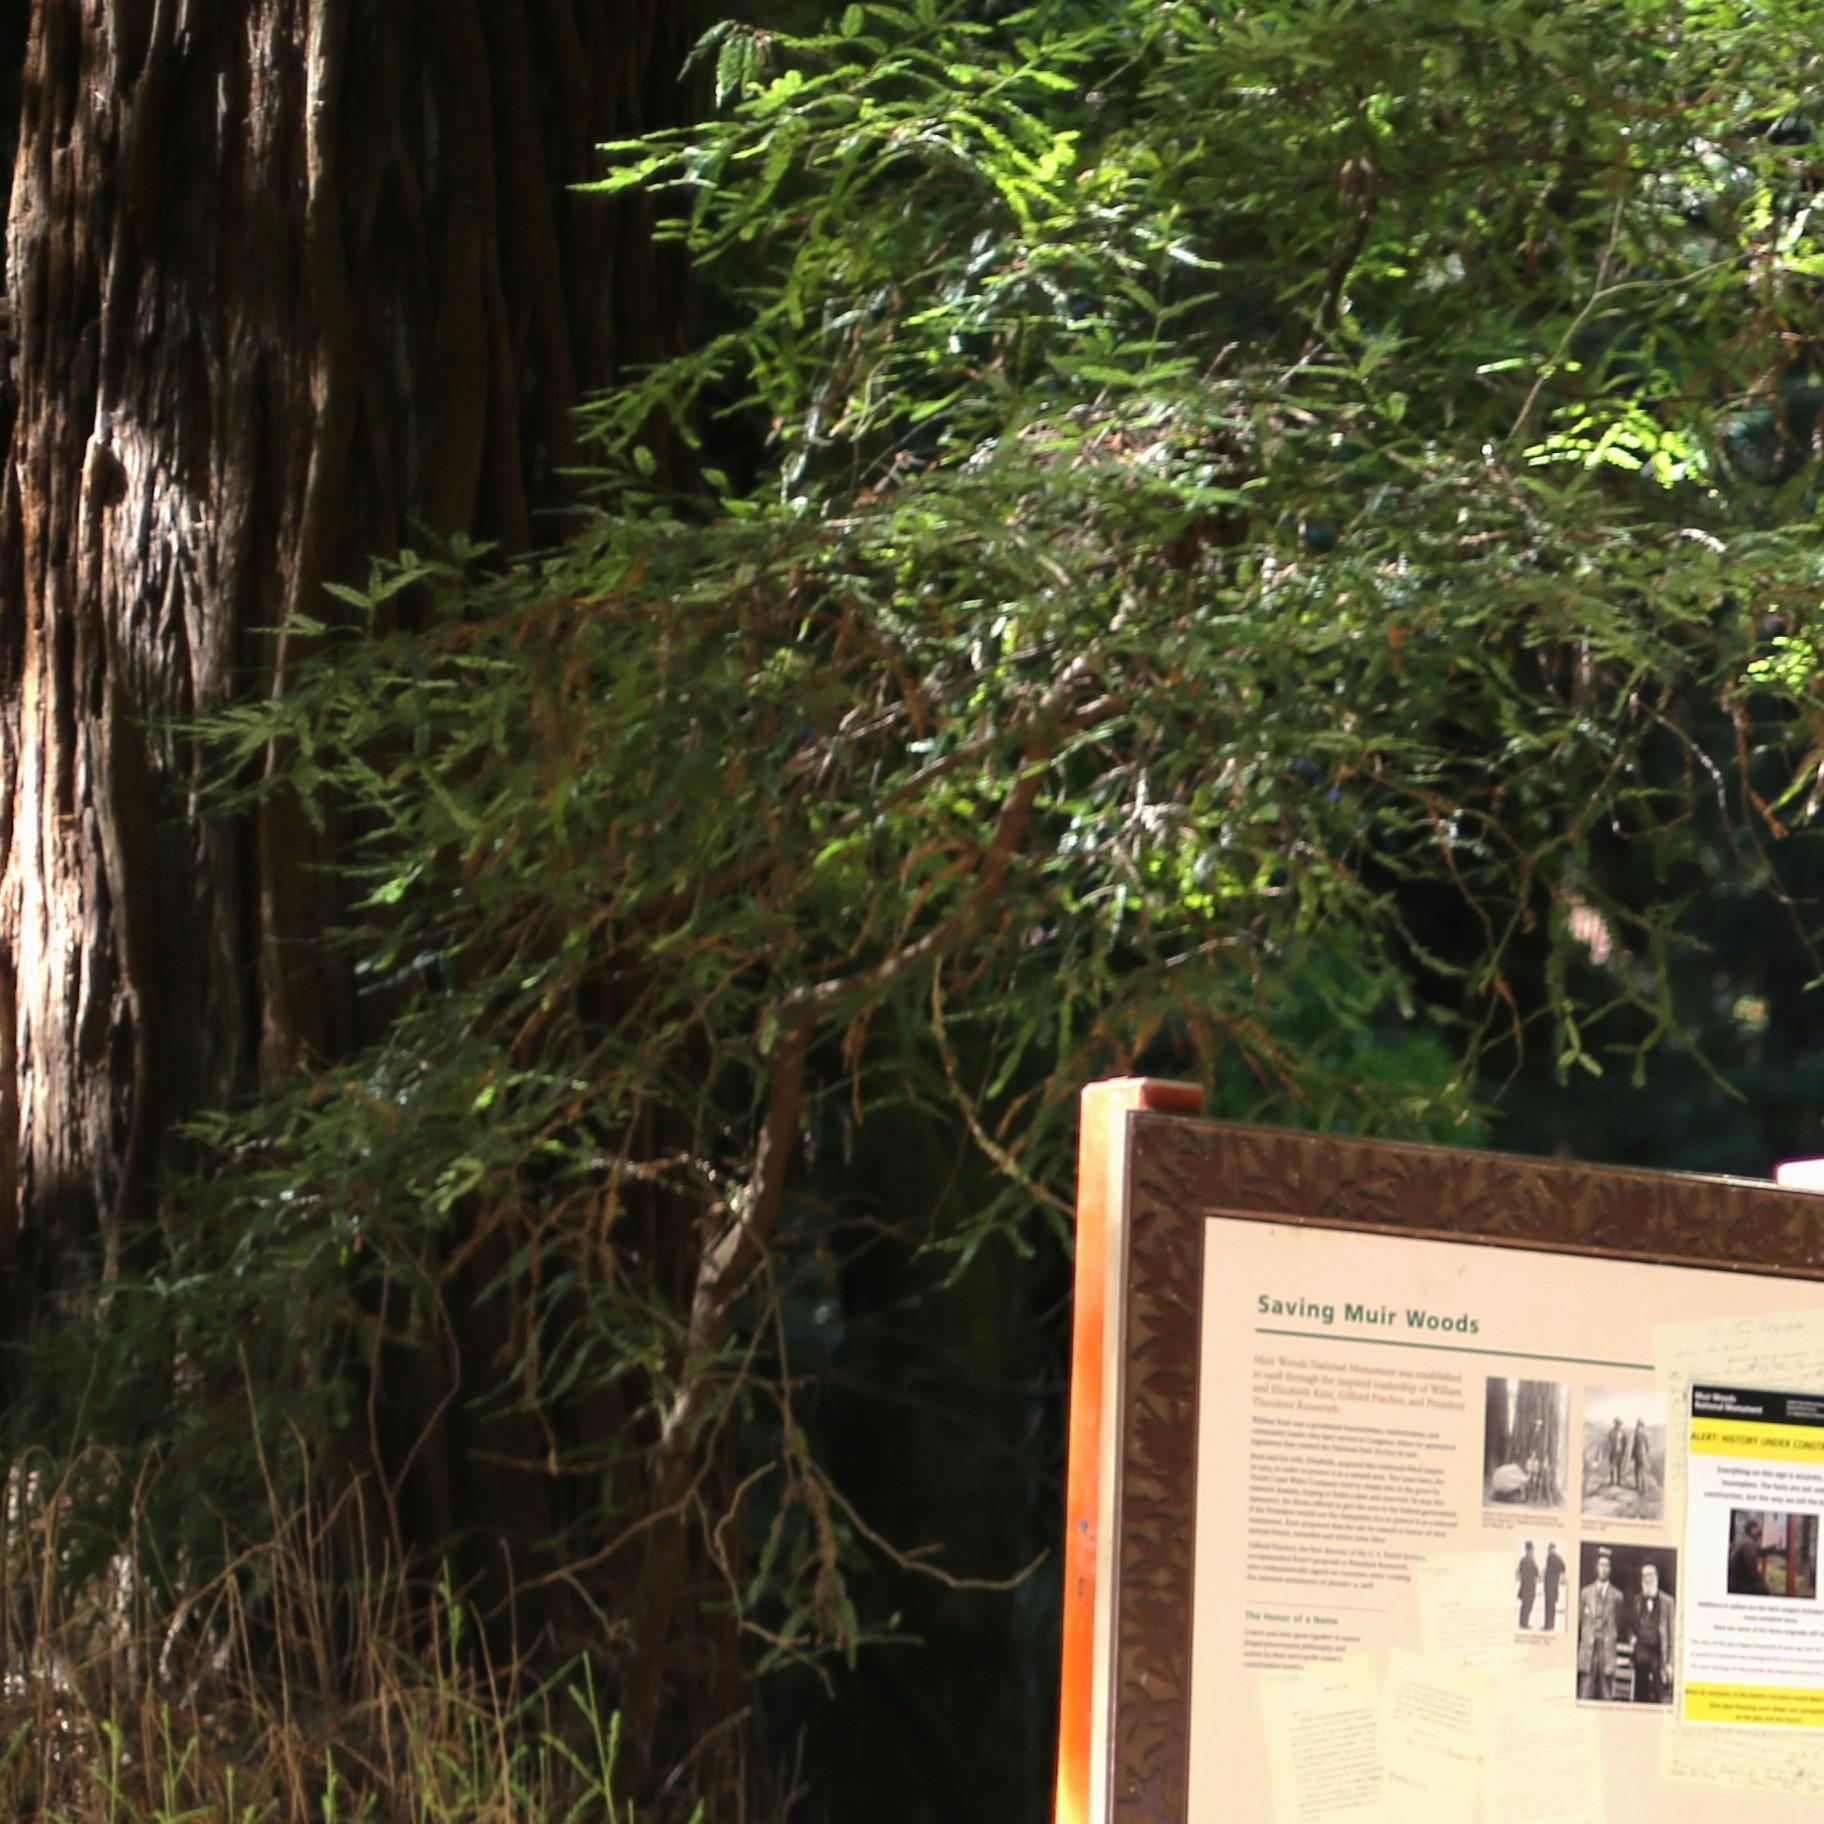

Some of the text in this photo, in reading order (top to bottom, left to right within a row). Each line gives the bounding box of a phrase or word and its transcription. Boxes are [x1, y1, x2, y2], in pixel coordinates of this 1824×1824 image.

[1258, 1294, 1480, 1333] Saving Muir Woods
[1694, 1401, 1763, 1415] National Monument
[1721, 1435, 1758, 1445] HISTORY
[1761, 1438, 1790, 1448] UNDER
[1245, 1610, 1260, 1620] The
[1293, 1613, 1303, 1622] of
